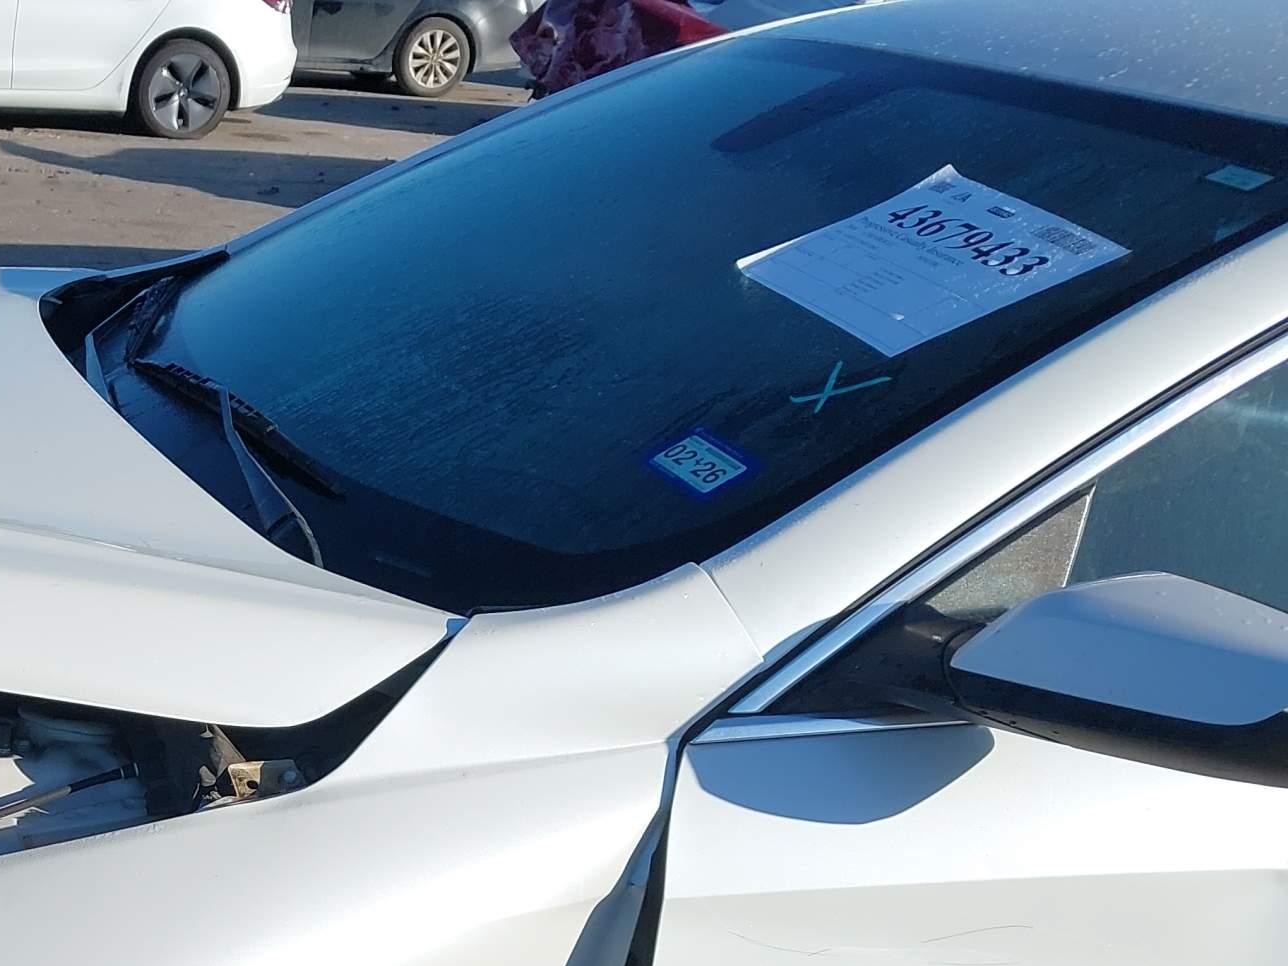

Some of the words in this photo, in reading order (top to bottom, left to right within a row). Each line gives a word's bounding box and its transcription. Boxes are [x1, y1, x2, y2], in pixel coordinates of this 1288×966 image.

[888, 205, 1051, 276] 43679433
[663, 444, 698, 466] 02
[691, 461, 727, 485] 26
